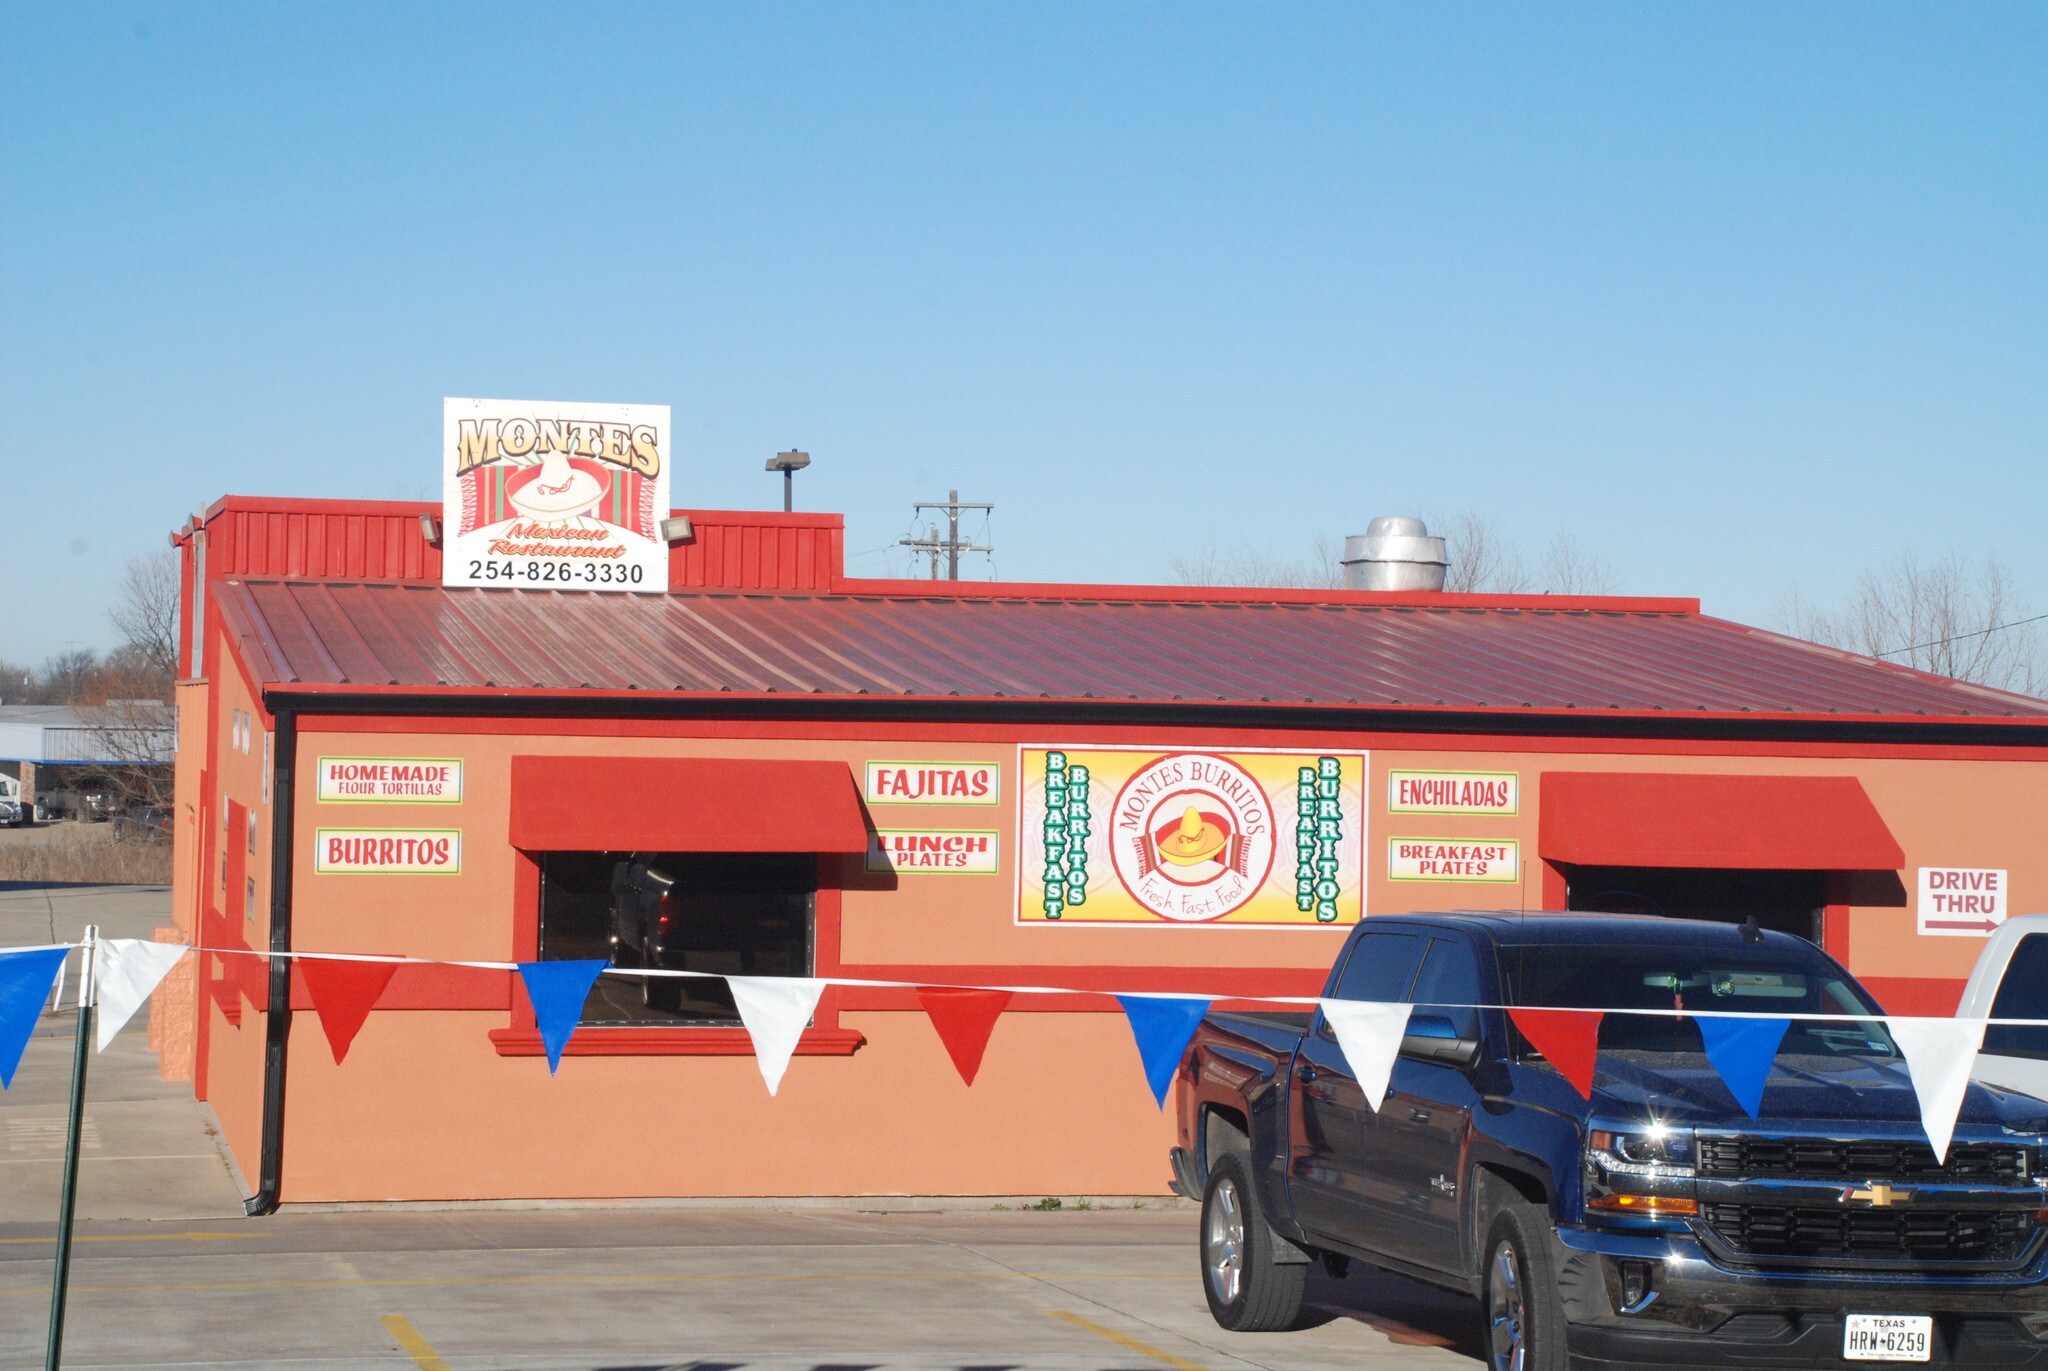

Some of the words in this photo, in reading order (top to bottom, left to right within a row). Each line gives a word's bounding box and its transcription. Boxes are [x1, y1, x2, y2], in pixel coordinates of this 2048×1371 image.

[456, 418, 661, 480] MONTES
[506, 522, 610, 541] Mexican
[487, 539, 628, 560] Restaurant
[469, 560, 644, 584] 254-826-3330
[330, 765, 450, 782] HOMEMADE
[877, 769, 989, 799] FAJITAS
[338, 782, 375, 794] FLOUR
[381, 782, 443, 796] TORTILLAS
[1119, 762, 1184, 832] MONTES
[1190, 761, 1265, 836] BURRITOS
[1399, 779, 1508, 808] ENCHILADAS
[878, 836, 988, 853] LUNCH
[1044, 752, 1067, 918] BREAKFAST
[1068, 766, 1090, 905] BURRITOS
[1297, 768, 1316, 911] BREAKFAST
[1316, 757, 1342, 921] BURRITOS
[328, 837, 450, 866] BURRITOS
[897, 852, 967, 867] PLATES
[1399, 844, 1507, 861] BREAKFAST
[1419, 860, 1488, 875] PLATES
[1215, 875, 1246, 906] Food
[1929, 871, 1998, 891] DRIVE
[1932, 894, 1995, 914] THRU
[1873, 1319, 1906, 1328] TEXAS
[1849, 1330, 1878, 1350] HRW
[1886, 1331, 1925, 1352] 6259
